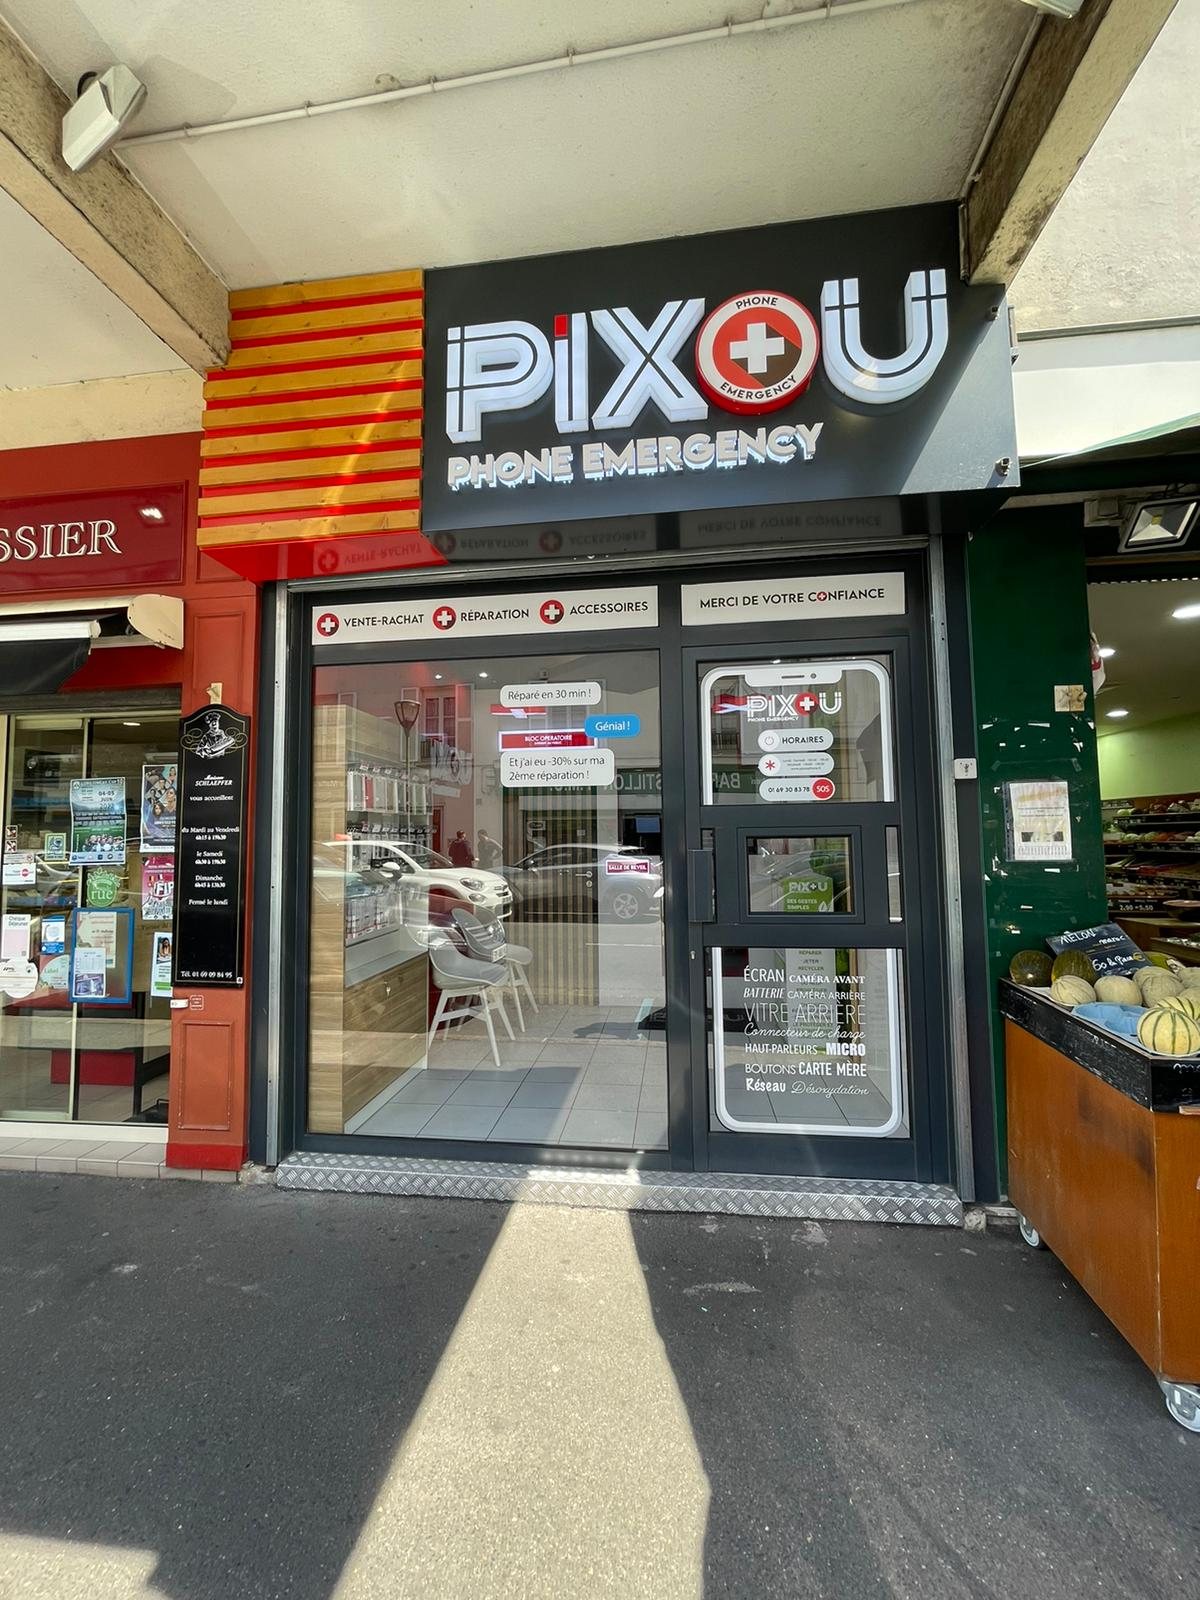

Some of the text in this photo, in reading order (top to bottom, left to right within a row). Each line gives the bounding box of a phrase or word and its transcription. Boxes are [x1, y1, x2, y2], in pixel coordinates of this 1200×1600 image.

[736, 296, 778, 310] PHONE
[720, 375, 797, 400] EMERGENCY
[447, 422, 824, 490] PHONE EMERGENCY
[700, 588, 885, 609] MERCI DE VOTRE CONFIANCE
[460, 608, 530, 622] RÉPARATION
[569, 601, 649, 615] ACCESSOIRES
[343, 613, 424, 628] VENTE-RACHAT
[508, 690, 540, 701] Réparé
[541, 691, 553, 699] en
[555, 689, 567, 698] 30
[568, 688, 586, 698] min
[595, 721, 625, 731] Génial
[782, 736, 824, 744] HORAIRES
[509, 757, 518, 767] Et
[519, 757, 532, 769] j'ai
[548, 756, 572, 766] -30%
[574, 758, 588, 766] sur
[509, 771, 535, 781] 2ème
[537, 771, 584, 781] réparation
[816, 785, 830, 793] SOS
[1059, 928, 1097, 945] MELON
[743, 965, 866, 984] ÉCRAN CAMÉRA AVANT
[743, 987, 786, 999] BATTERIE
[787, 988, 827, 999] CAMÉRA
[828, 989, 866, 1000] ARRIÈRE
[743, 1002, 789, 1023] VITRE
[795, 1000, 867, 1025] ARRIÈRE
[744, 1022, 866, 1044] Connecteur de charge
[744, 1042, 866, 1056] HAUT-PARLEURS MICRO
[745, 1060, 867, 1077] BOUTONS CARTE MÈRE
[745, 1077, 870, 1098] Réseau Désoxydation
